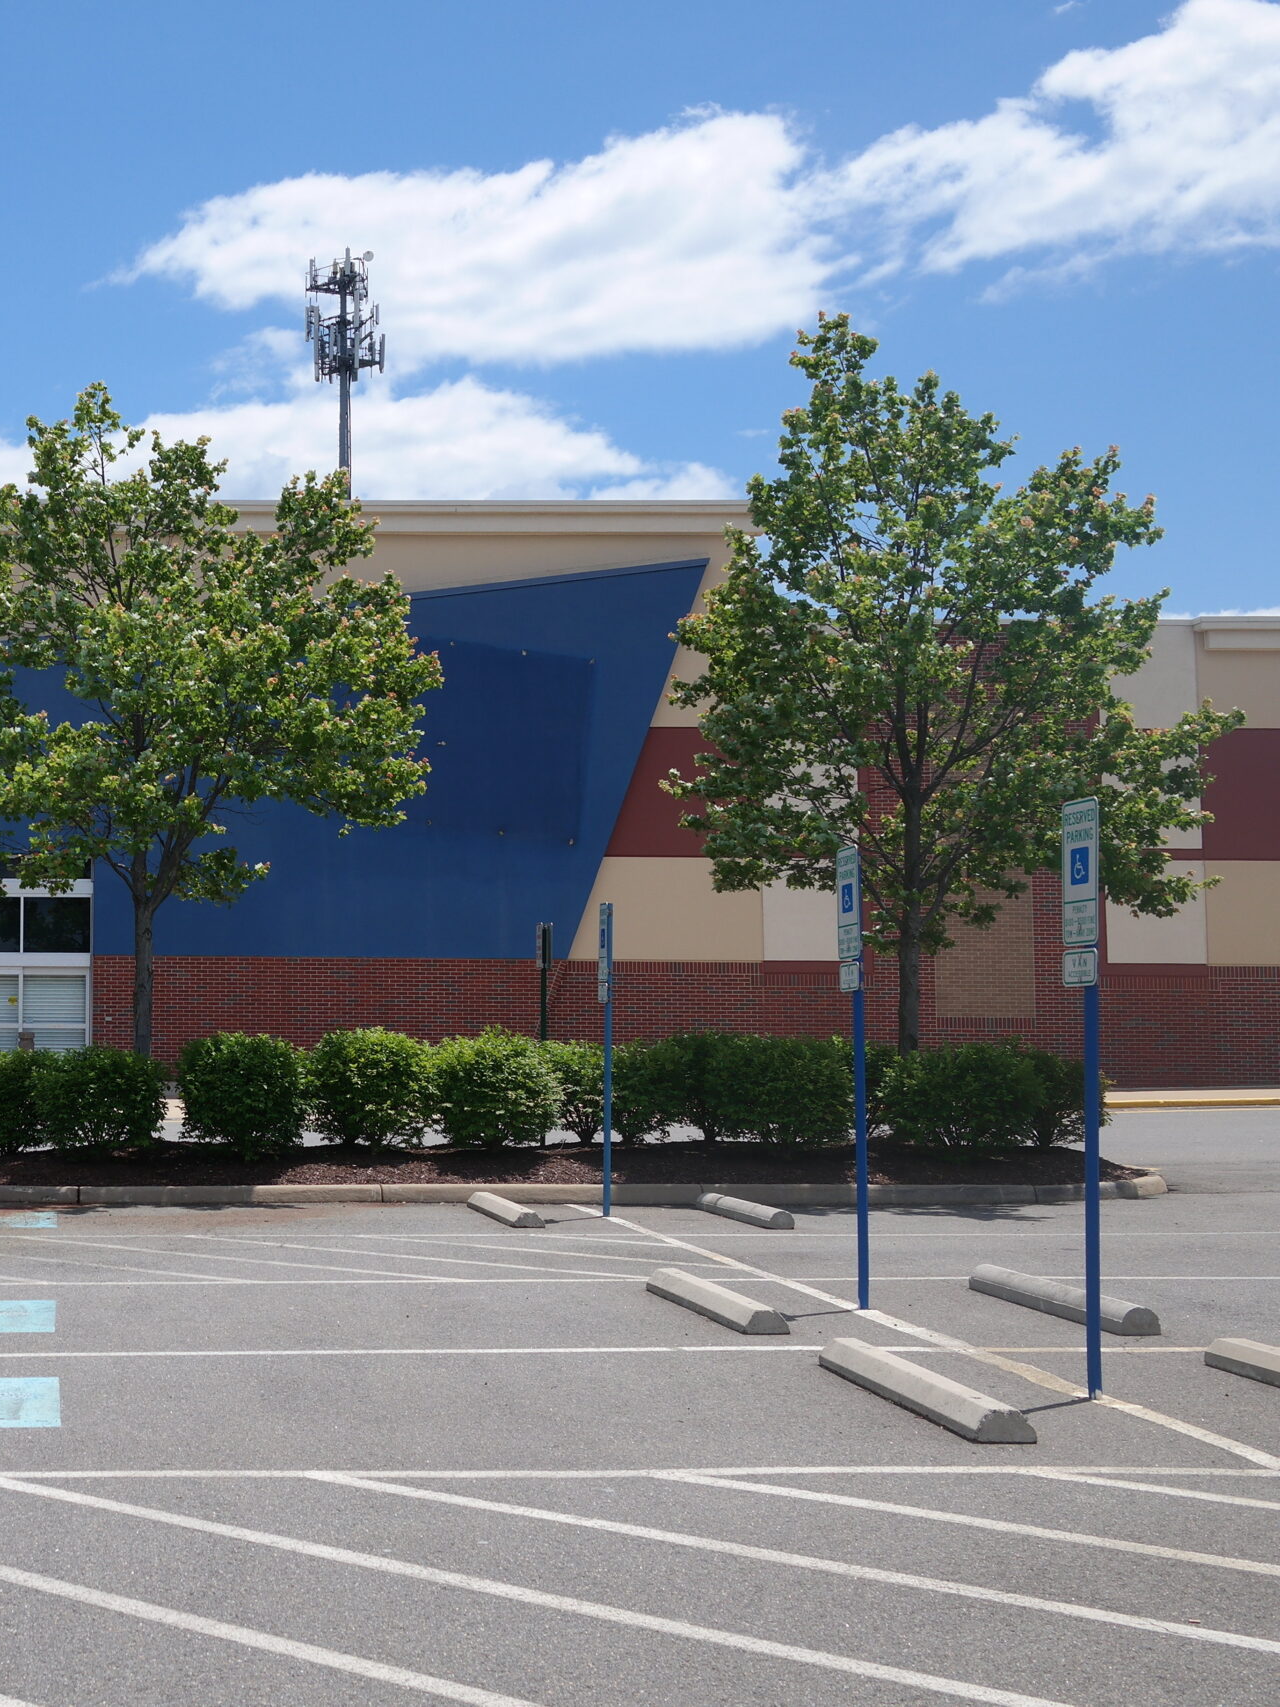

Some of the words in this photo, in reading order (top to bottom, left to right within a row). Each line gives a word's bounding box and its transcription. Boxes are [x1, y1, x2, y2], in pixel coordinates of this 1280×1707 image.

[1064, 808, 1095, 827] RESERVED
[1066, 827, 1094, 844] PARKING
[1072, 958, 1088, 968] VAN
